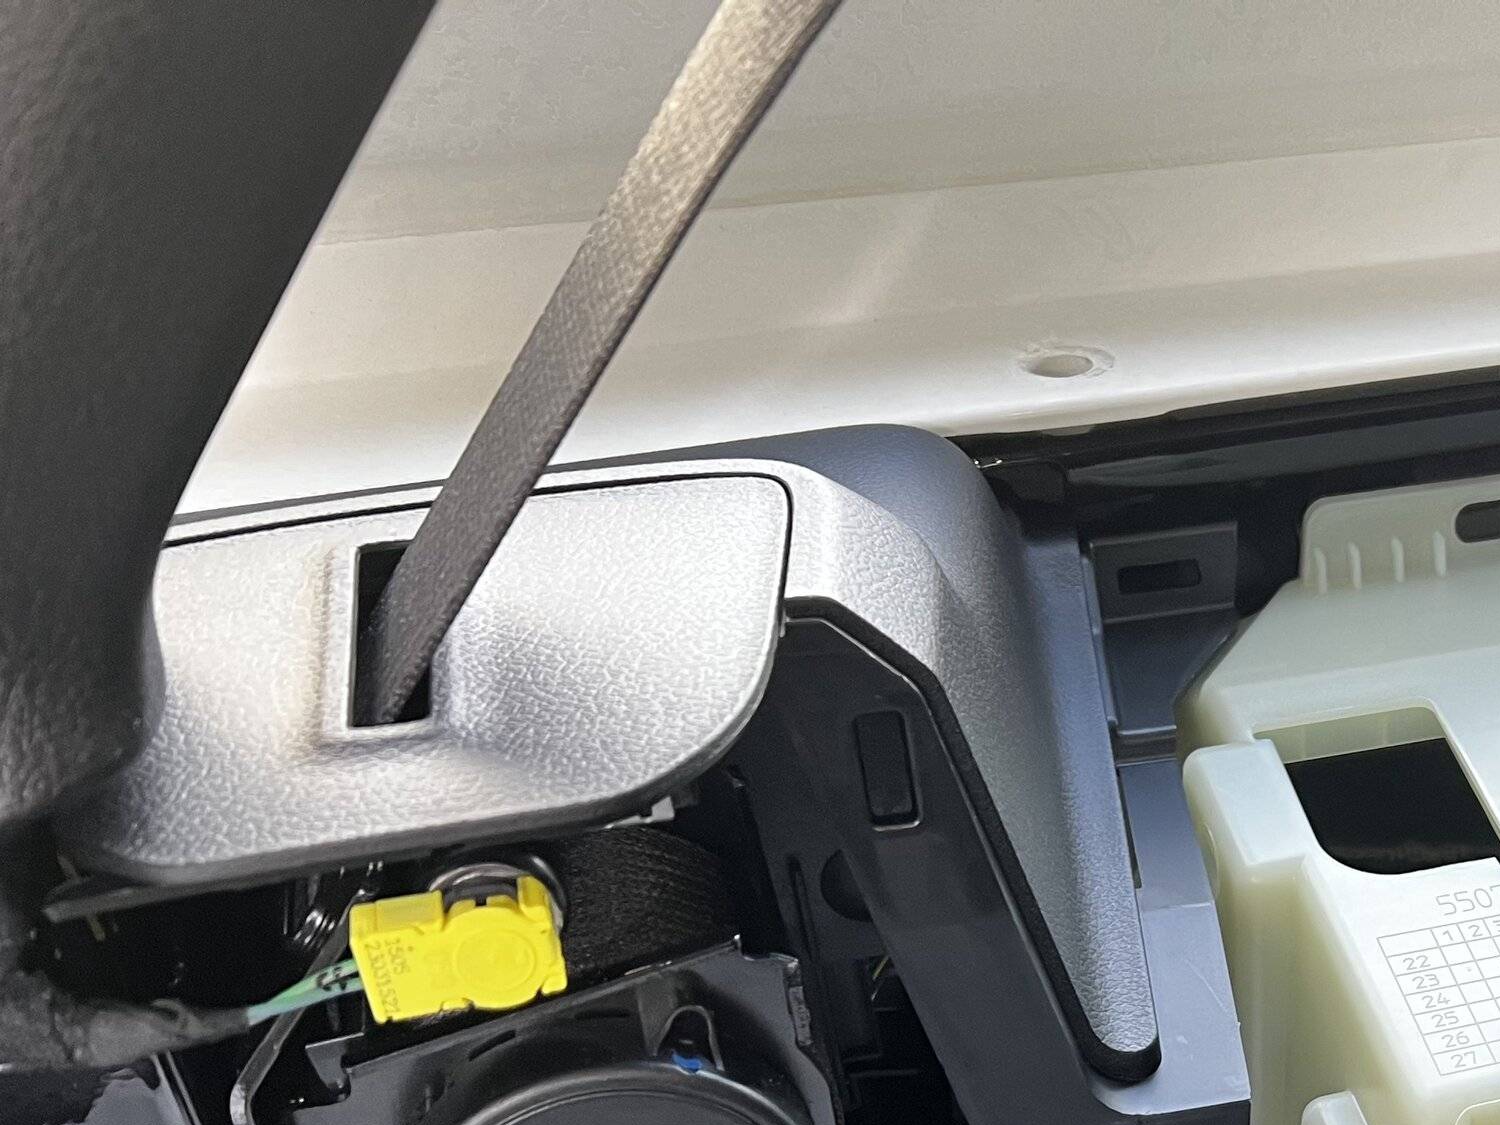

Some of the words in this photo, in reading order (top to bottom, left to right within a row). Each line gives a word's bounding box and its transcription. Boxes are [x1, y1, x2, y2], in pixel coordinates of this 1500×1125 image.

[1441, 929, 1454, 942] 1
[1467, 924, 1483, 939] 2
[1402, 954, 1431, 972] 22
[1411, 973, 1440, 990] 23
[1421, 992, 1451, 1009] 24
[1431, 1010, 1460, 1029] 25
[1441, 1031, 1470, 1049] 26
[1450, 1050, 1478, 1069] 27
